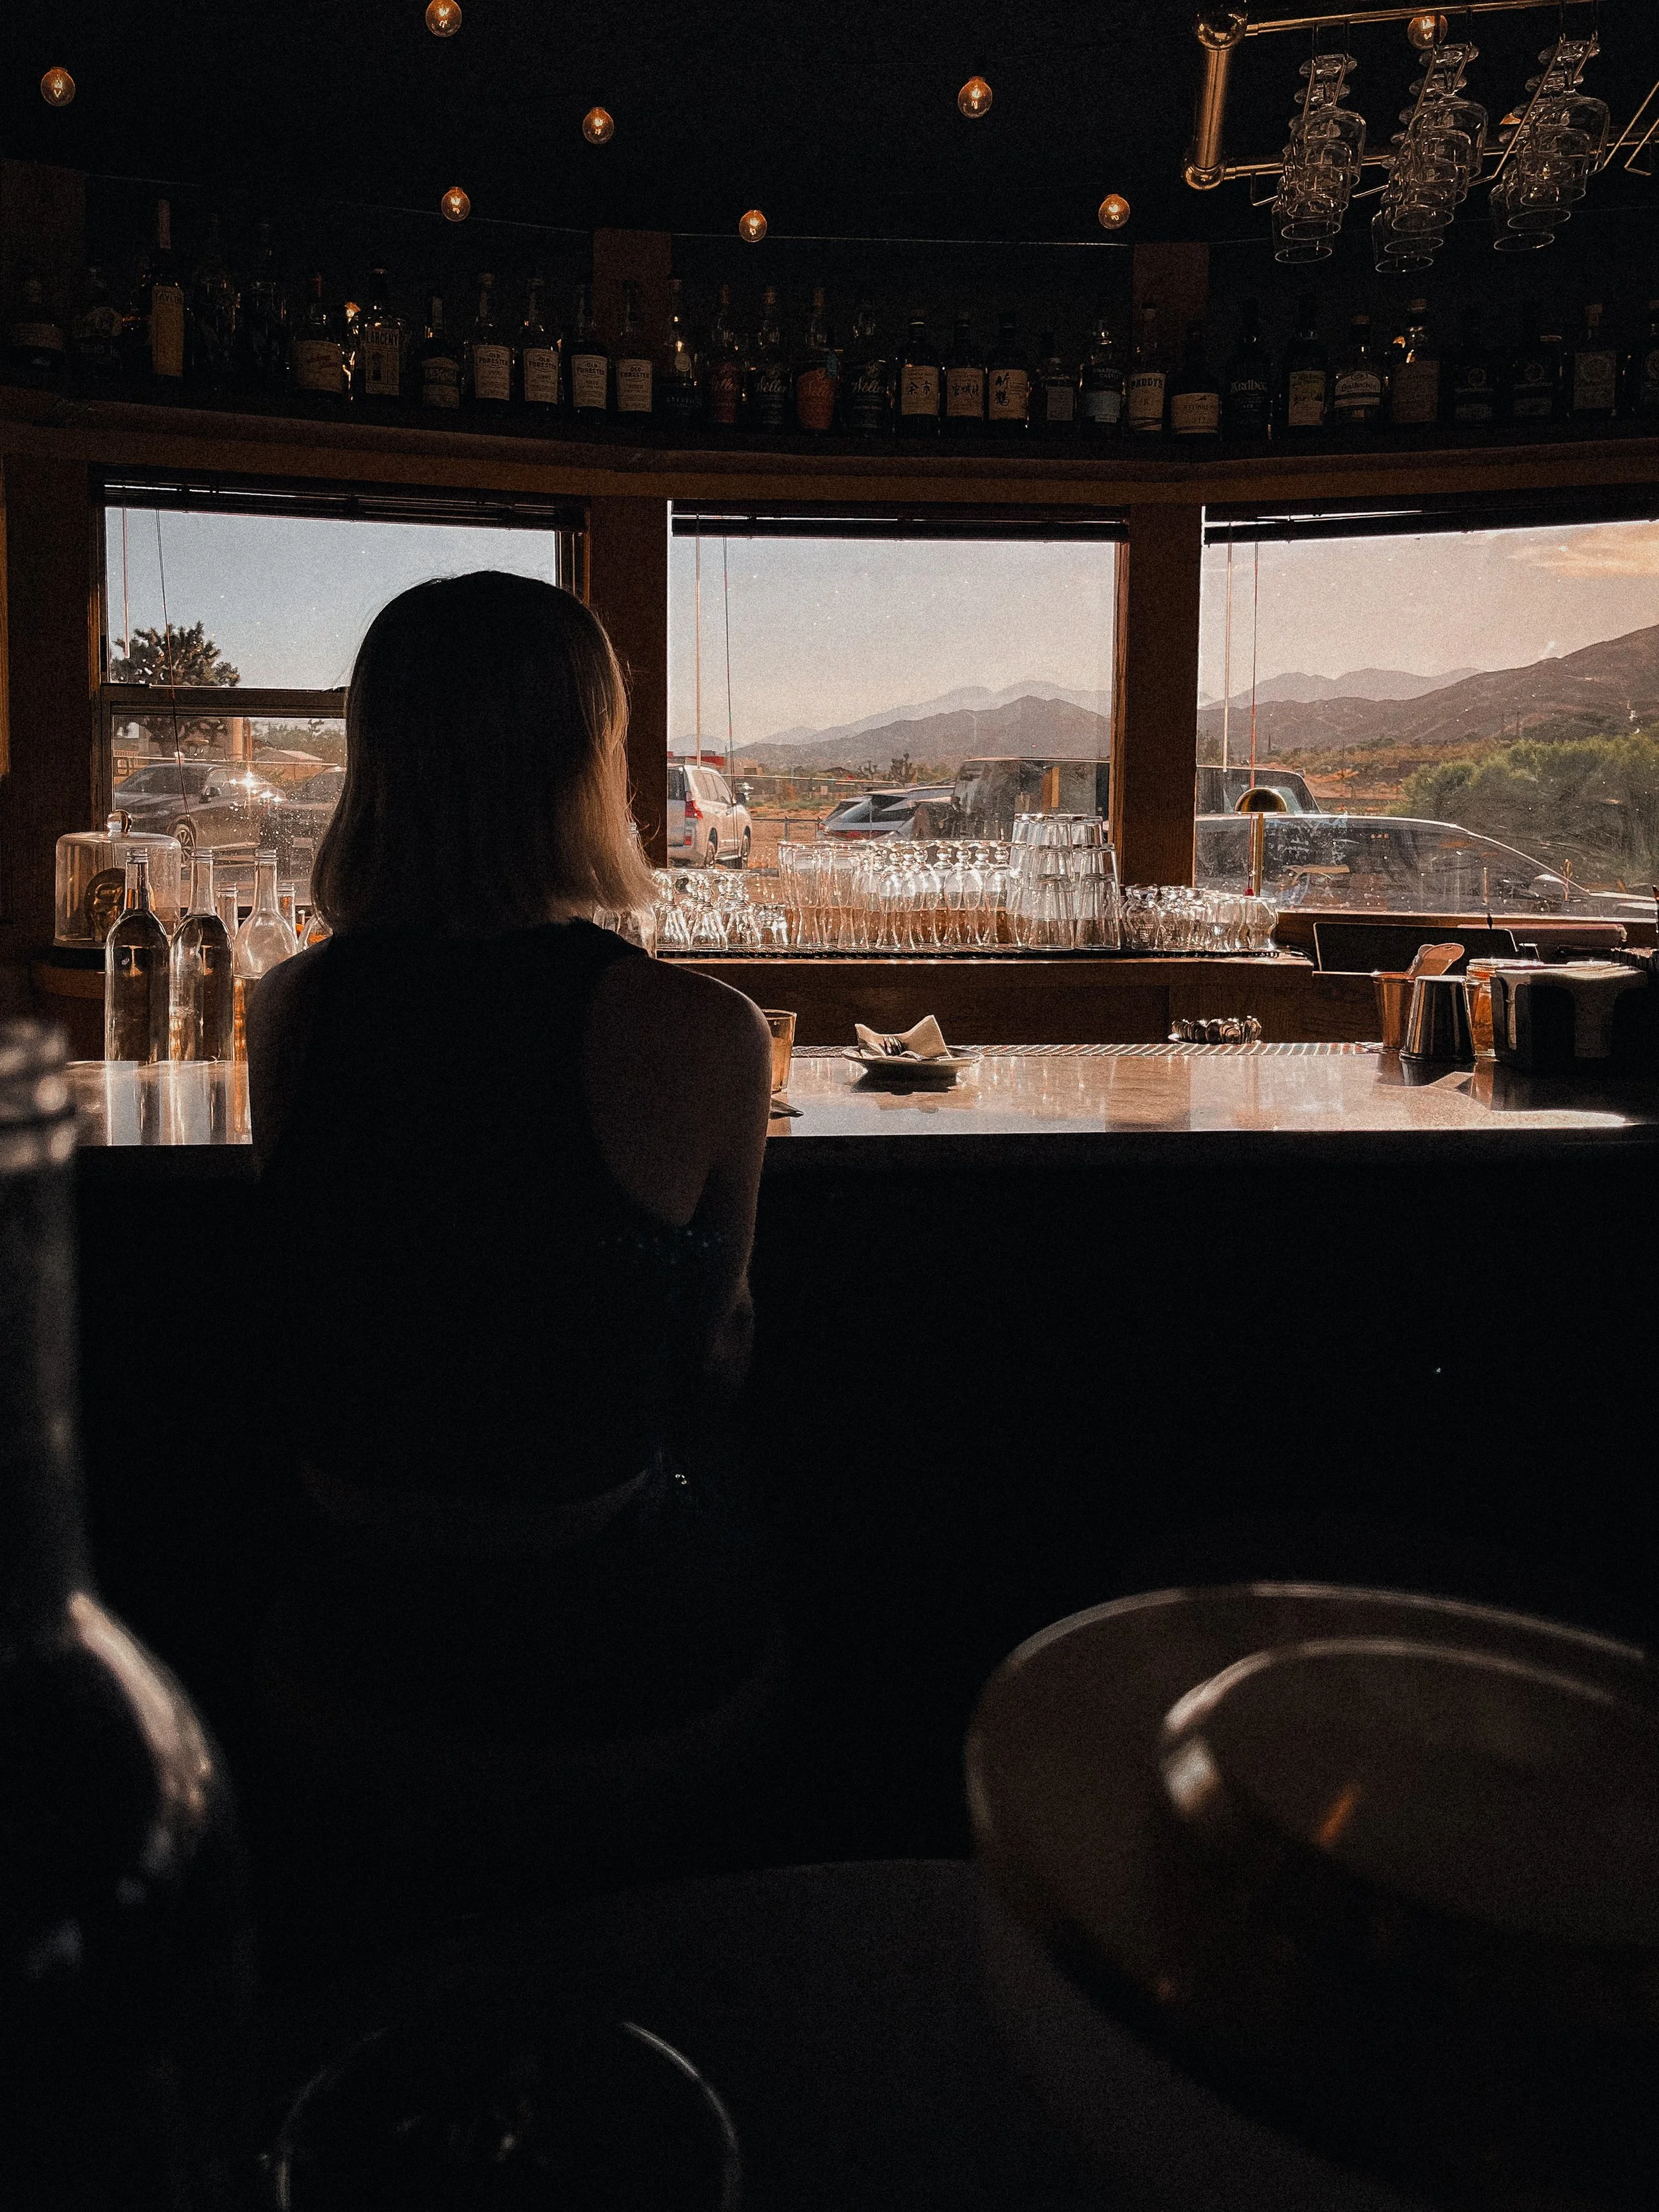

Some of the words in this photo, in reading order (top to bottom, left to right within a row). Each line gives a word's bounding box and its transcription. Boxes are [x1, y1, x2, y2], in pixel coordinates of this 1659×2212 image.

[366, 331, 398, 346] LARCENY
[478, 357, 508, 366] FORESTER
[529, 361, 557, 370] FORESTER
[577, 367, 605, 376] FORESTER
[905, 380, 932, 396] 余市
